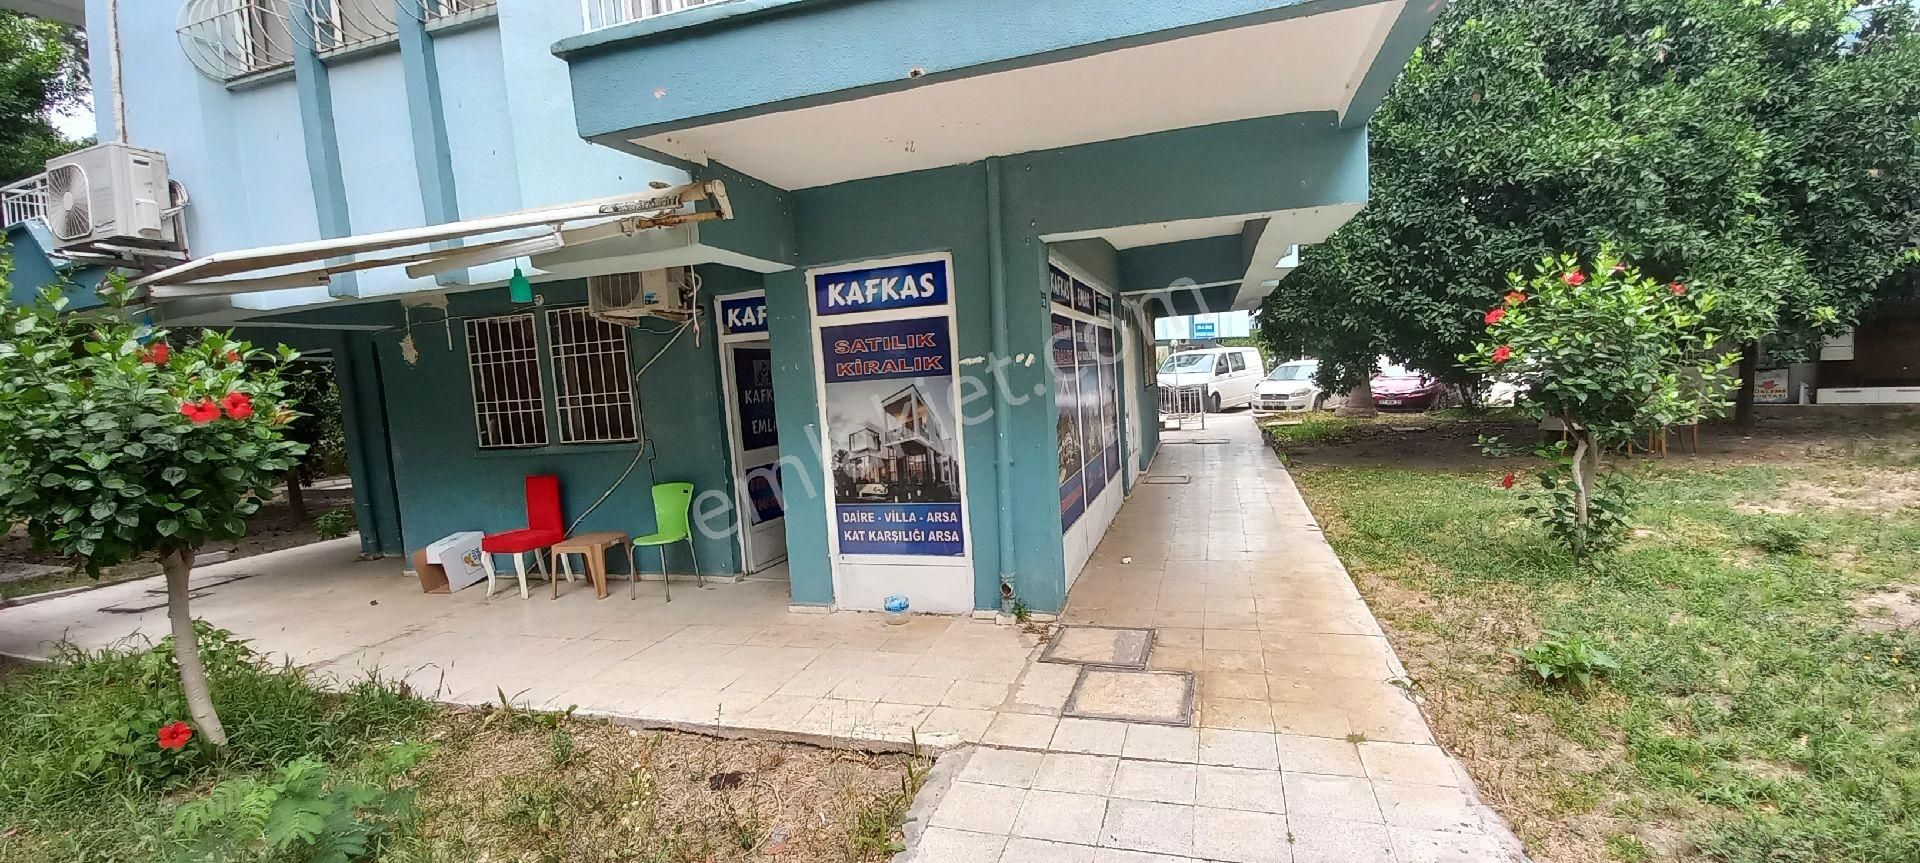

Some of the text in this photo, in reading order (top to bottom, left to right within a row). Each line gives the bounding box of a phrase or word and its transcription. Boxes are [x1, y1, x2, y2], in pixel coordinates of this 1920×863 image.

[828, 272, 935, 307] KAFKAS
[727, 304, 767, 328] KAF
[834, 332, 937, 355] SATILIK
[836, 355, 944, 377] KİRALIK
[745, 388, 773, 404] KAFK
[752, 418, 776, 434] EML
[843, 510, 875, 523] DAİRE
[884, 509, 917, 523] VİLLA
[926, 512, 958, 523] ARSA
[844, 528, 960, 544] KAT KARŞILIĞI ARSA
